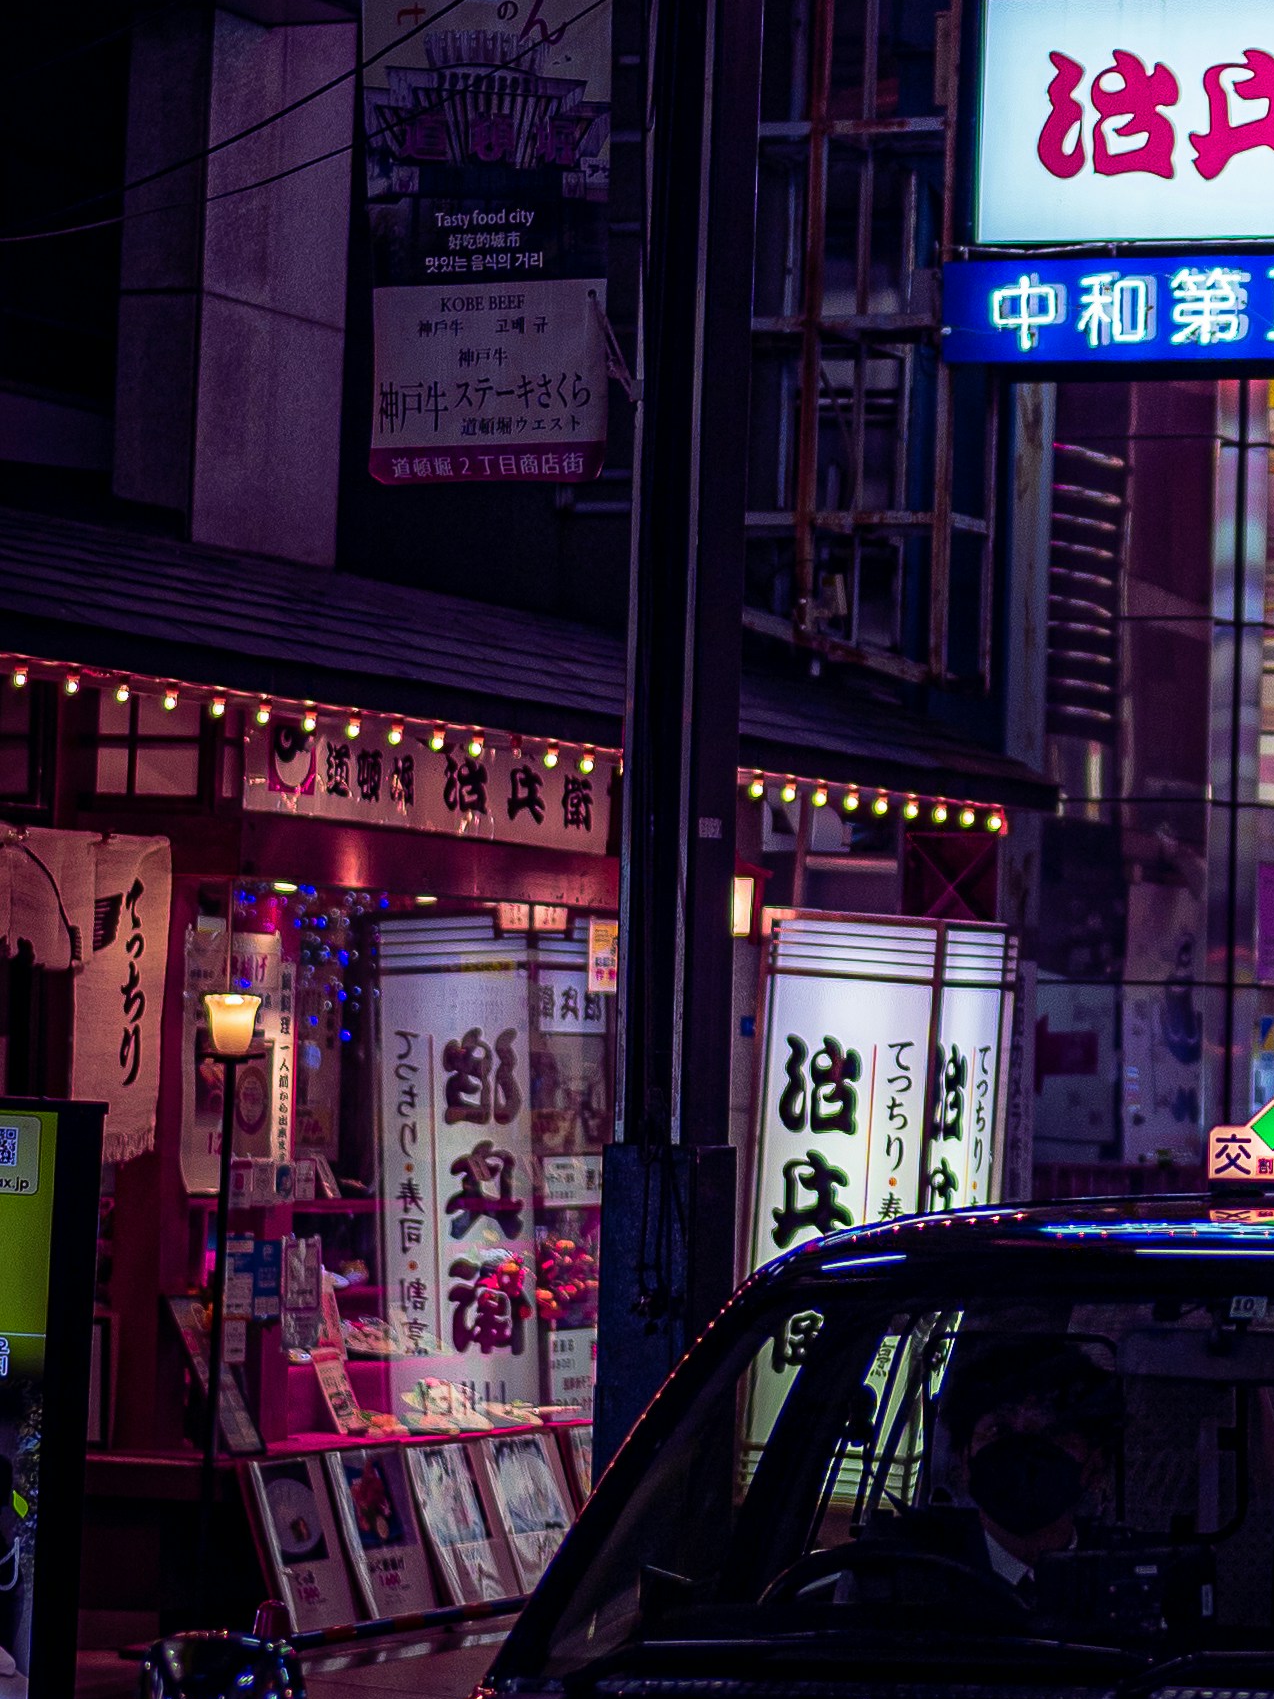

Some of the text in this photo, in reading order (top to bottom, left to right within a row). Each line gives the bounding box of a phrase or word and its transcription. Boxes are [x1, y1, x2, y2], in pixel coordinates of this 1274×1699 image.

[435, 208, 535, 230] Tasty food city
[448, 232, 521, 251] 好吃的城市
[425, 251, 544, 274] 맛있는 음식의 거리
[440, 295, 526, 313] KOBE BEEF
[495, 316, 525, 334] 고베
[461, 414, 581, 436] 道頓堀ウエスト
[391, 452, 584, 479] 道頓堀2丁目商店街
[1215, 1134, 1252, 1175] 交
